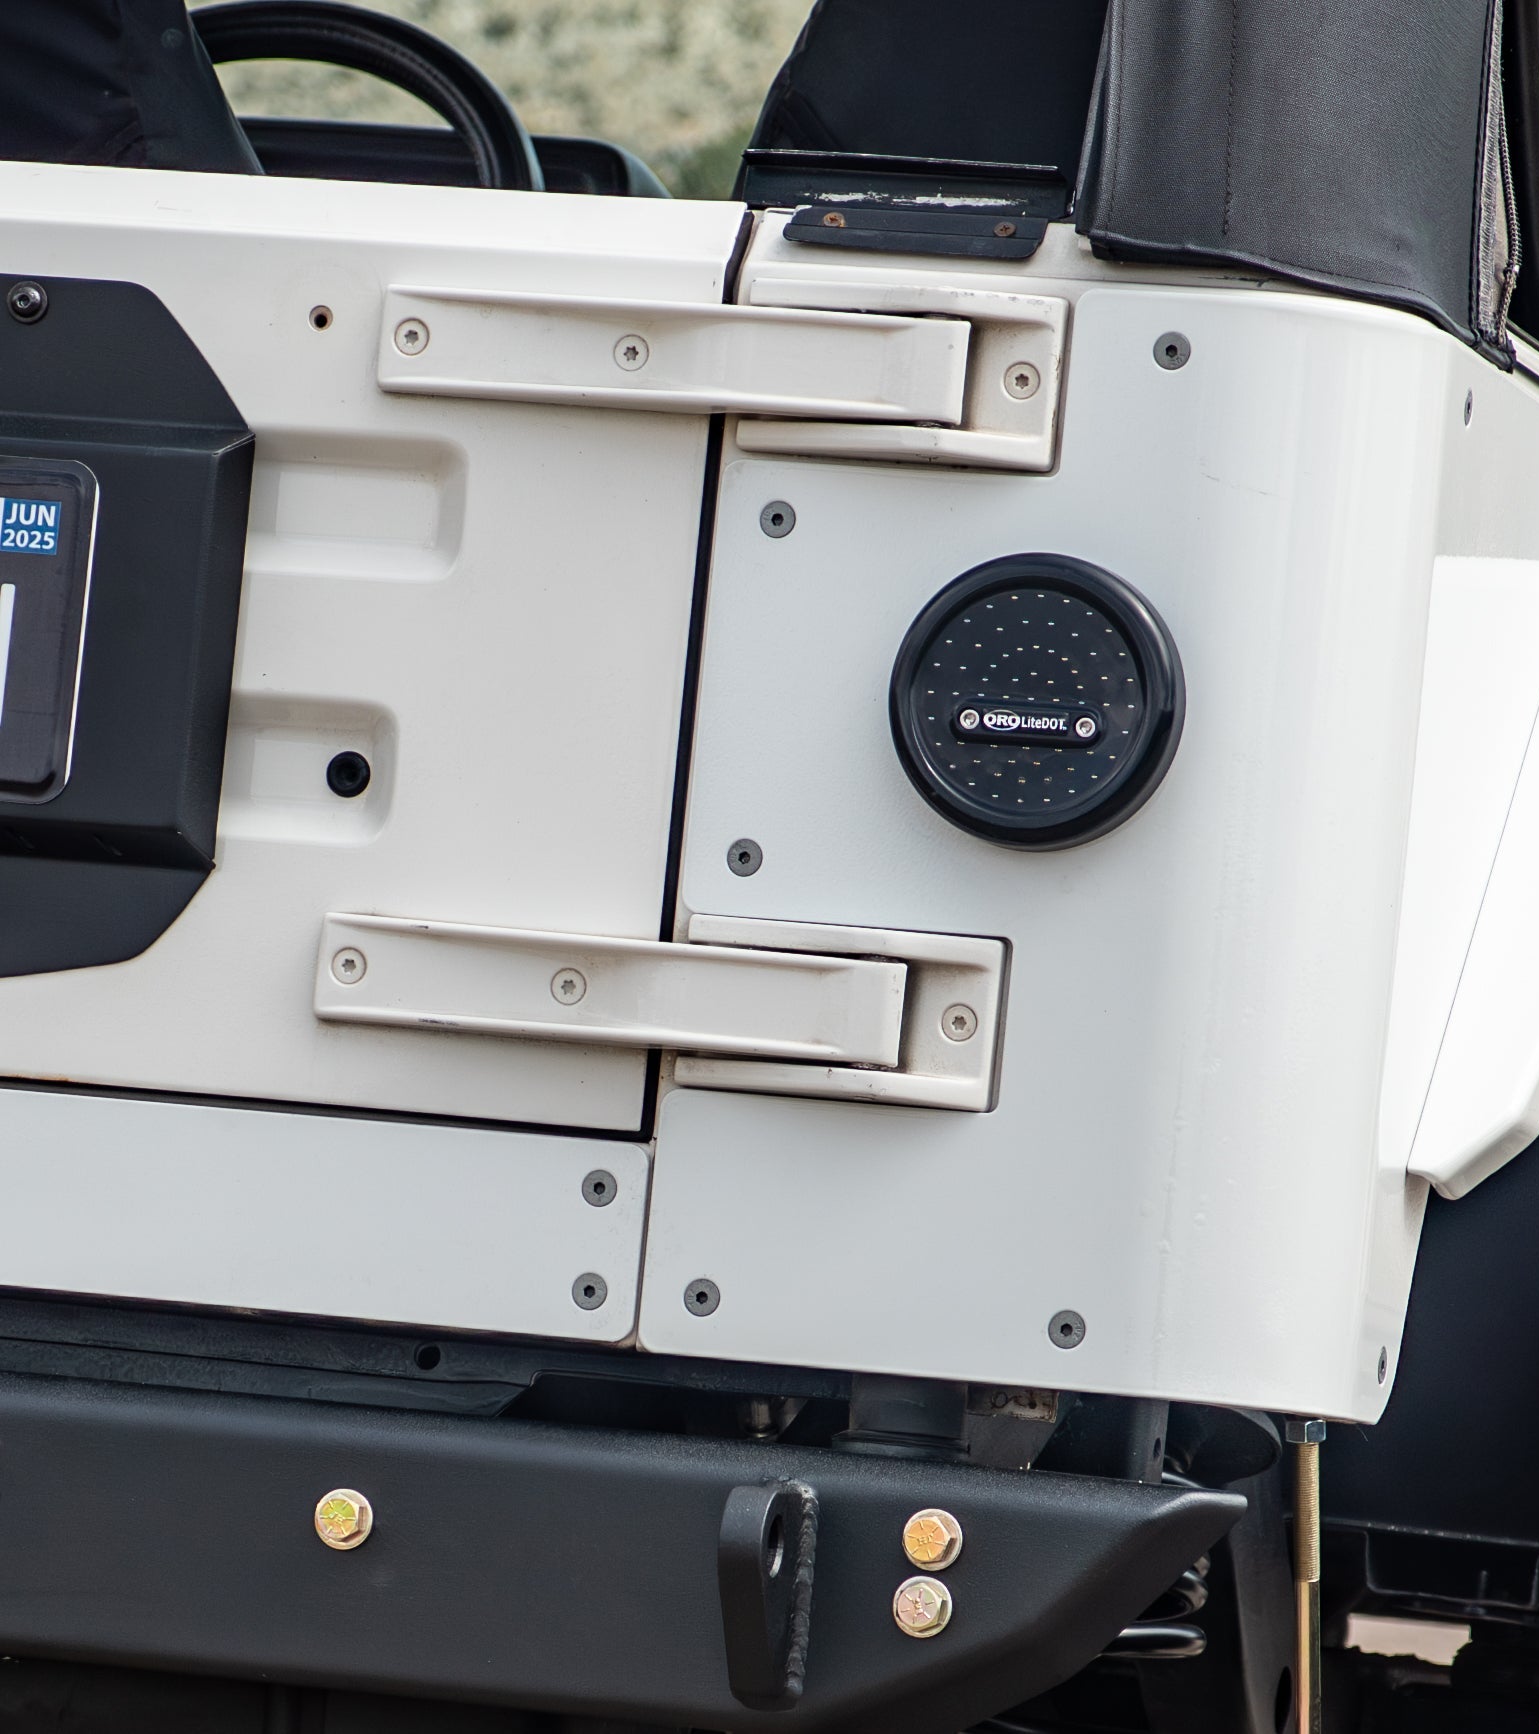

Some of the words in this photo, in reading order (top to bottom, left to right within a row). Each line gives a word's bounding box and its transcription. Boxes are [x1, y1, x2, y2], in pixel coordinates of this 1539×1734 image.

[5, 503, 56, 527] JUN
[2, 529, 55, 550] 2025
[983, 713, 1021, 729] ORO
